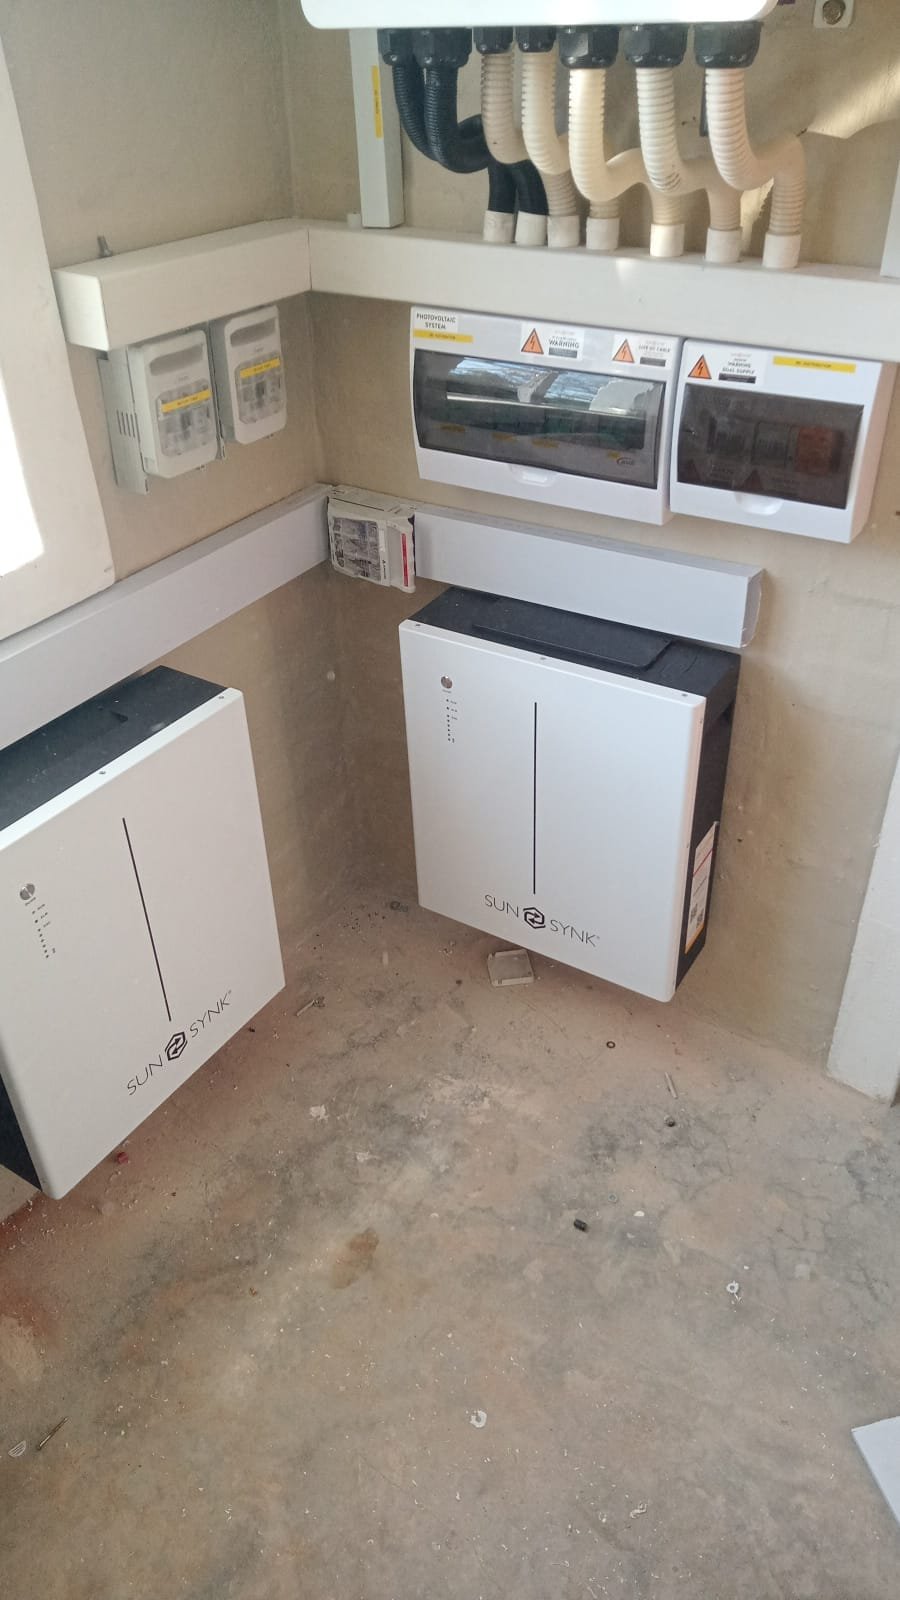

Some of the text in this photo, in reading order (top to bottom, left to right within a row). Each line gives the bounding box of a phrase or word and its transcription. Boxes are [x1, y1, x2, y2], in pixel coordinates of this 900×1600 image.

[416, 312, 457, 323] PHOTOVOLTAIC
[424, 321, 447, 329] SYSTEM
[549, 338, 580, 349] WARNING
[484, 894, 597, 947] SUN SYNK
[126, 993, 231, 1096] SUN SYNK
